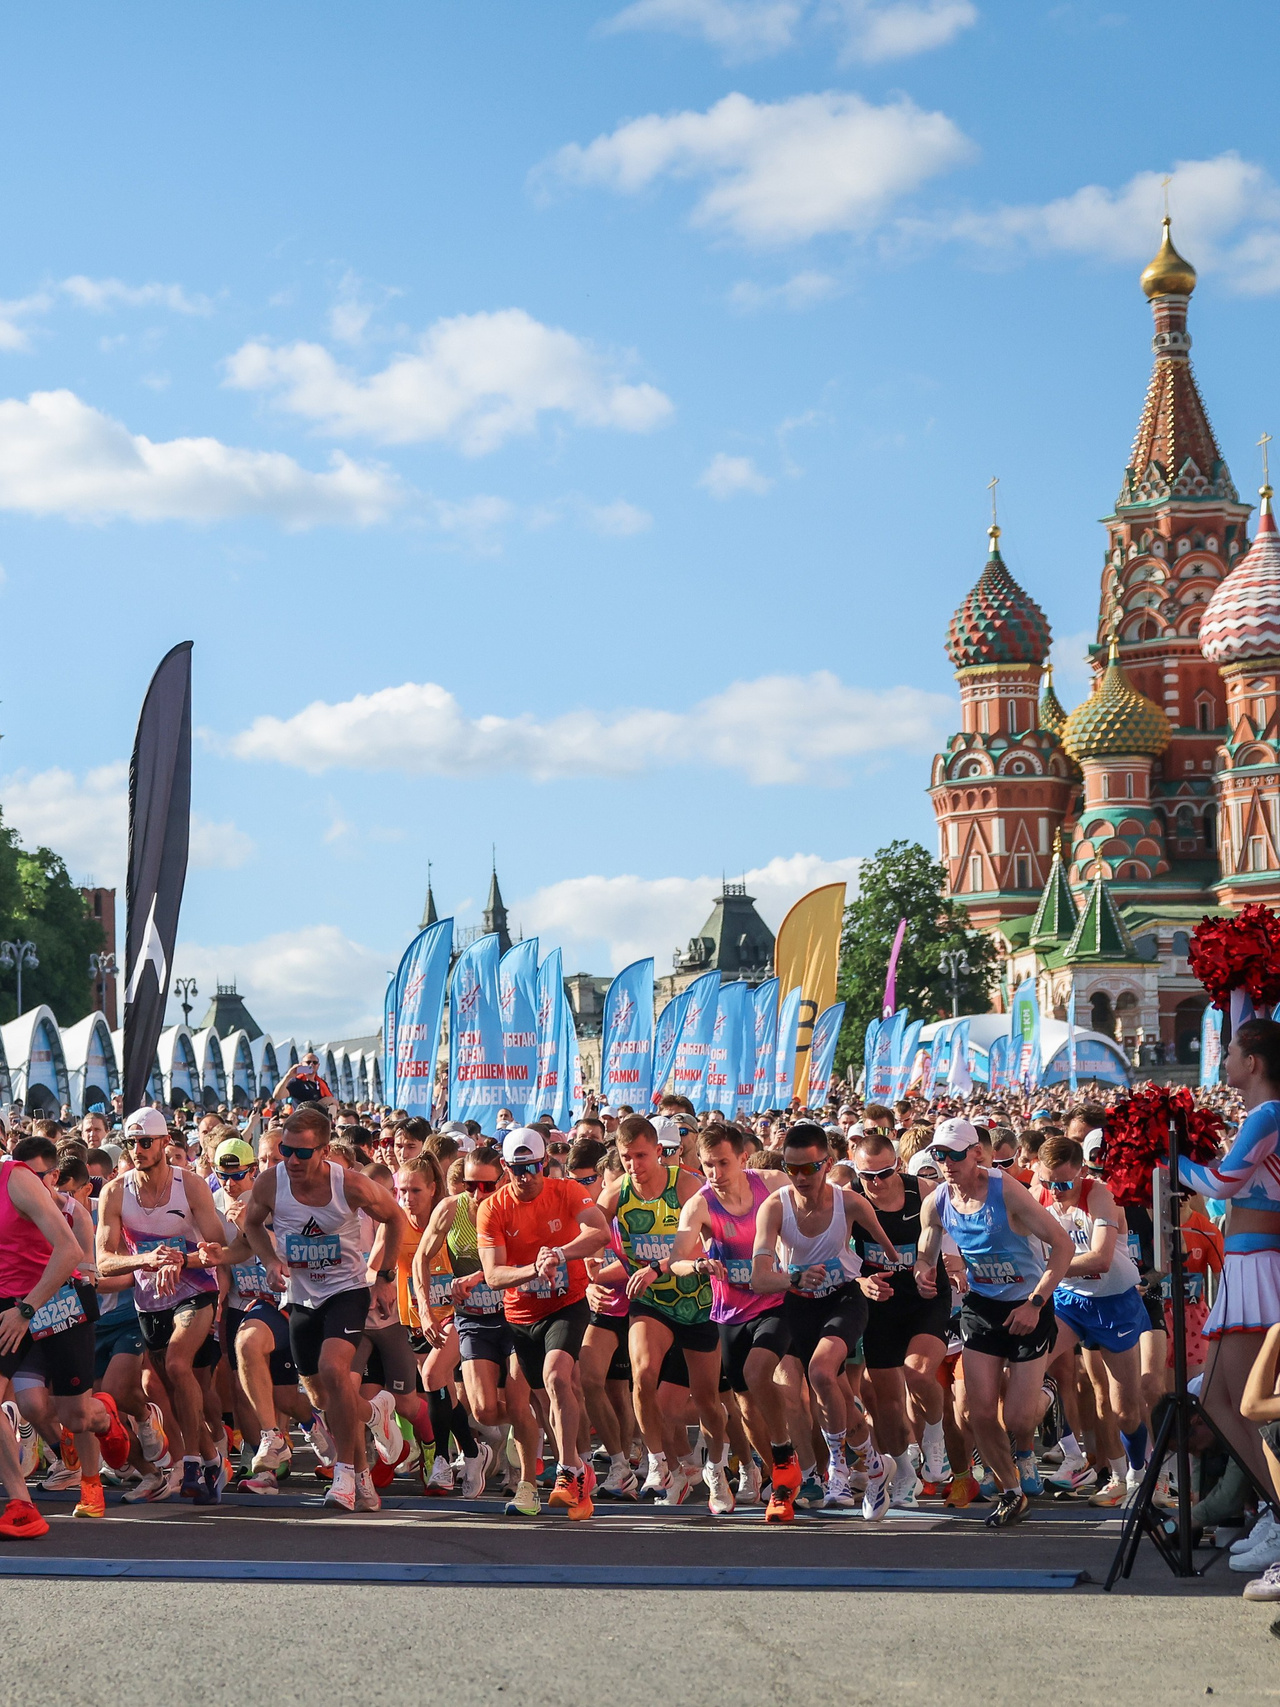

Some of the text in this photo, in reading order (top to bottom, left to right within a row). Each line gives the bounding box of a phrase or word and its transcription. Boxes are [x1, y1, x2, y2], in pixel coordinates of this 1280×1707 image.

[458, 1030, 481, 1047] БЕГУ
[458, 1047, 485, 1064] ВСЕМ
[610, 1040, 649, 1055] ВЫБЕГАЮ
[402, 1061, 429, 1078] СЕБЕ
[609, 1056, 621, 1069] ЗА
[458, 1065, 504, 1082] СЕРДЦЕМ
[609, 1069, 639, 1084] РАМКИ
[675, 1069, 702, 1081] РАМКИ
[708, 1073, 727, 1086] СЕБЕ
[458, 1085, 505, 1108] #ЗАБЕГ
[609, 1087, 648, 1105] #ЗАБЕГ
[548, 1218, 562, 1234] 10
[290, 1244, 336, 1261] 37097
[1191, 1248, 1203, 1260] 10
[731, 1267, 752, 1283] 38
[972, 1262, 1016, 1278] 31729
[1006, 1275, 1015, 1283] A
[537, 1287, 567, 1299] 5KM A
[828, 1286, 837, 1294] A
[441, 1297, 450, 1305] A
[1189, 1296, 1197, 1304] A
[32, 1296, 80, 1329] 35252
[52, 1316, 78, 1334] 5KM A
